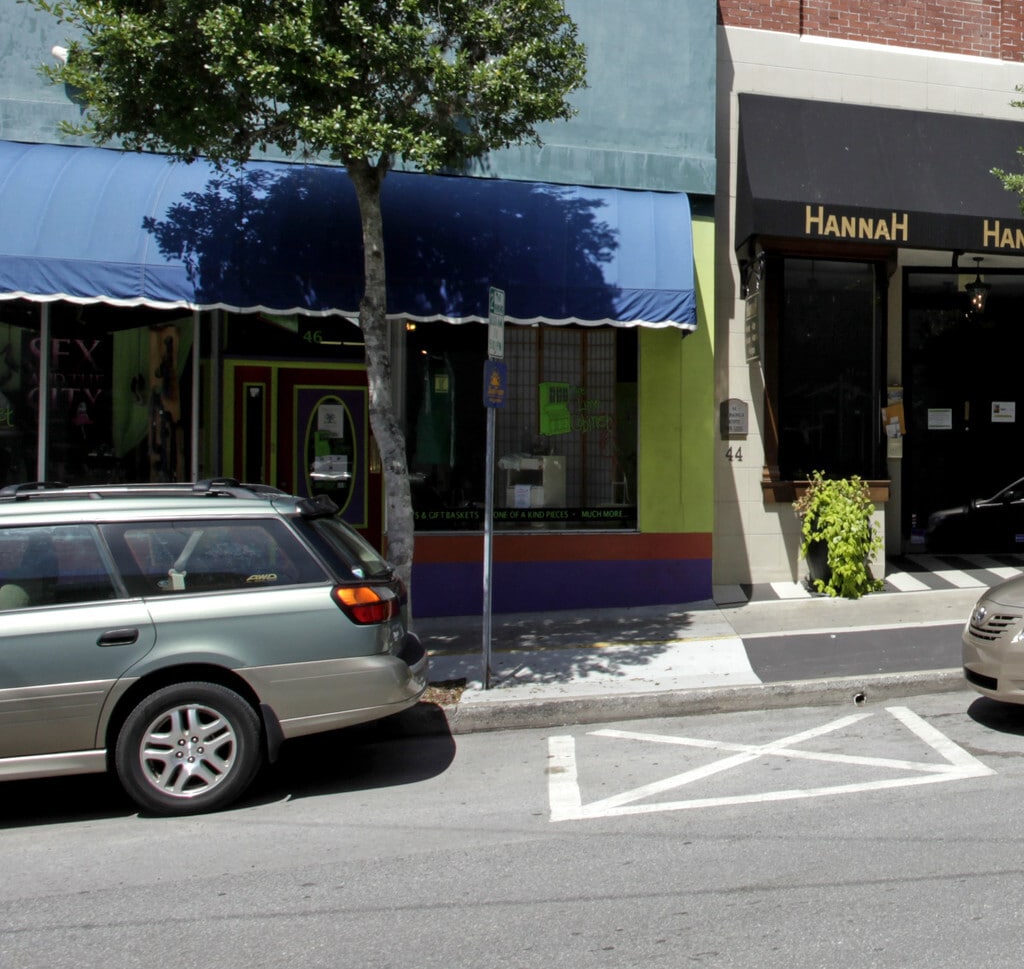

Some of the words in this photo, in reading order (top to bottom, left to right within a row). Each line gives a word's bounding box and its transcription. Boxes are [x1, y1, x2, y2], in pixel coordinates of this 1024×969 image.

[805, 205, 908, 241] HANNAH
[303, 330, 322, 343] 46
[725, 446, 743, 462] 44
[246, 572, 278, 582] AWD
